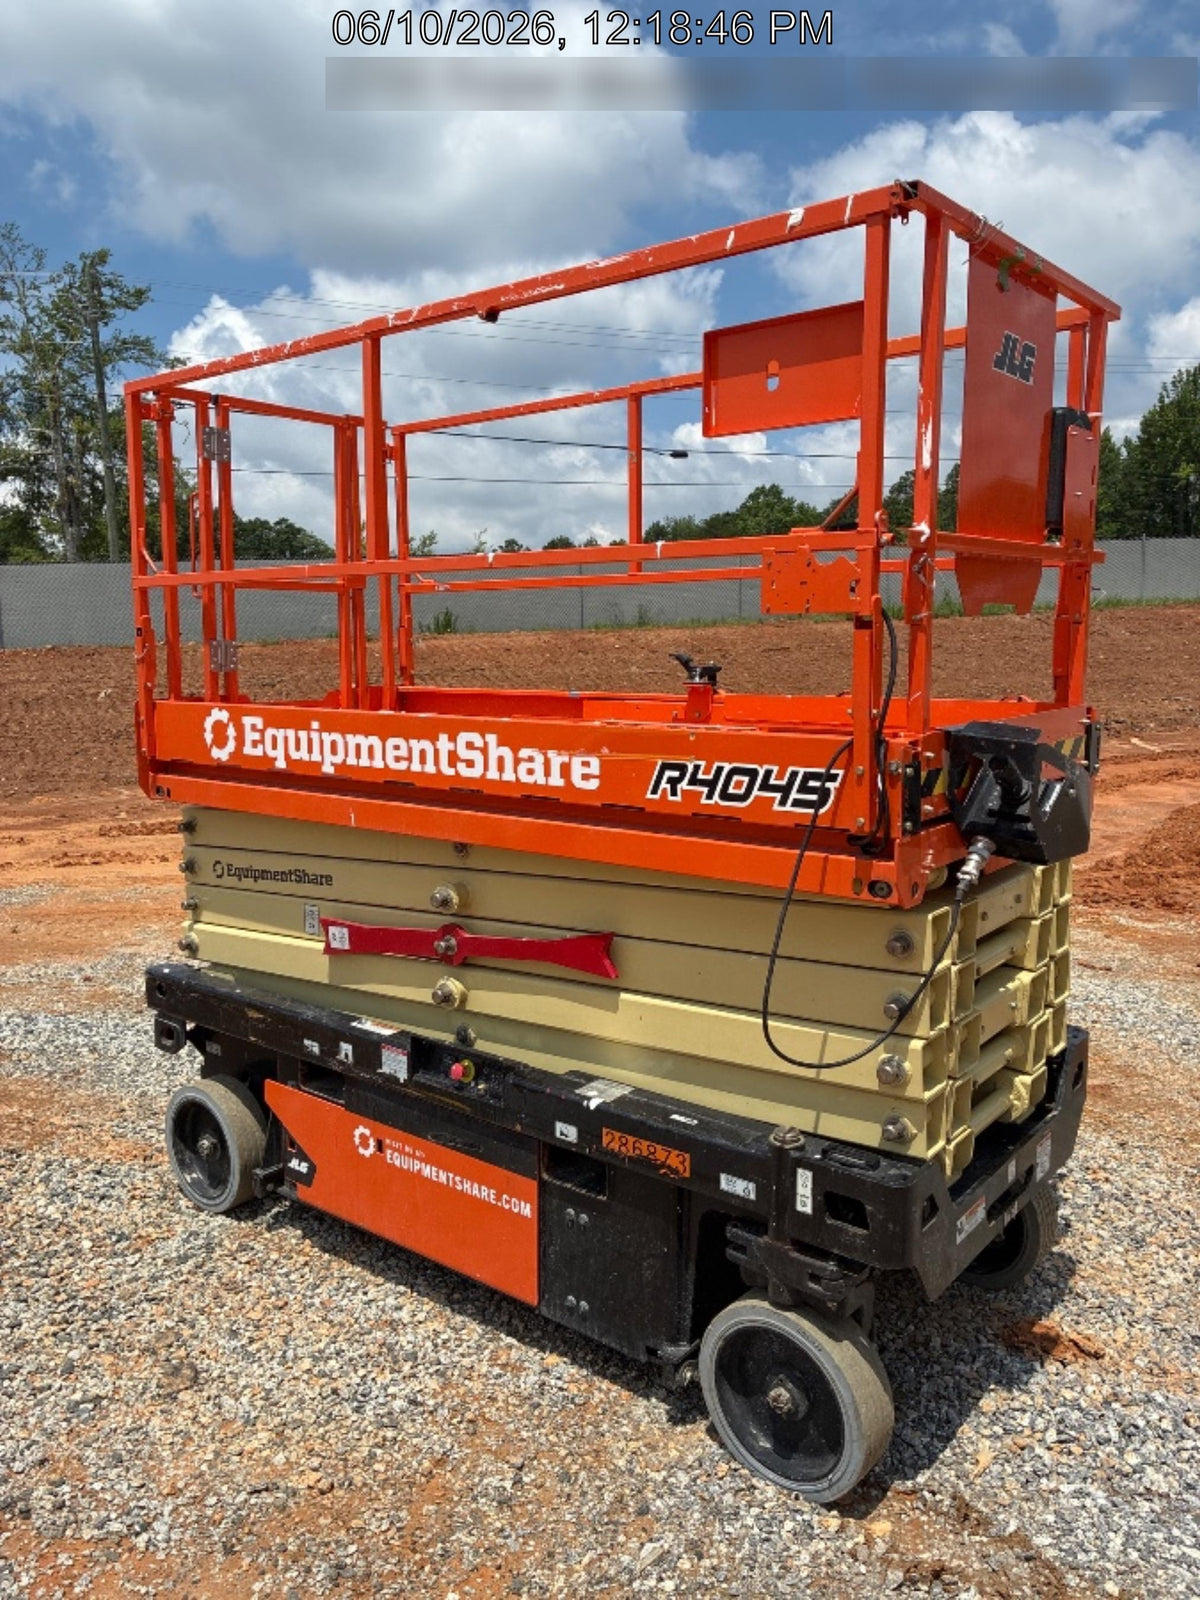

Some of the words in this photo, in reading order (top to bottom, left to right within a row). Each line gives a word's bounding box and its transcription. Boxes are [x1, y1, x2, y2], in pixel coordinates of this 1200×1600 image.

[992, 330, 1037, 386] JLG
[242, 715, 601, 791] EquipmentShare
[646, 760, 845, 814] R4045
[226, 863, 333, 887] EquipmentShare
[604, 1130, 688, 1176] 286873
[385, 1149, 532, 1219] EQUIPMENTSHARE.COM
